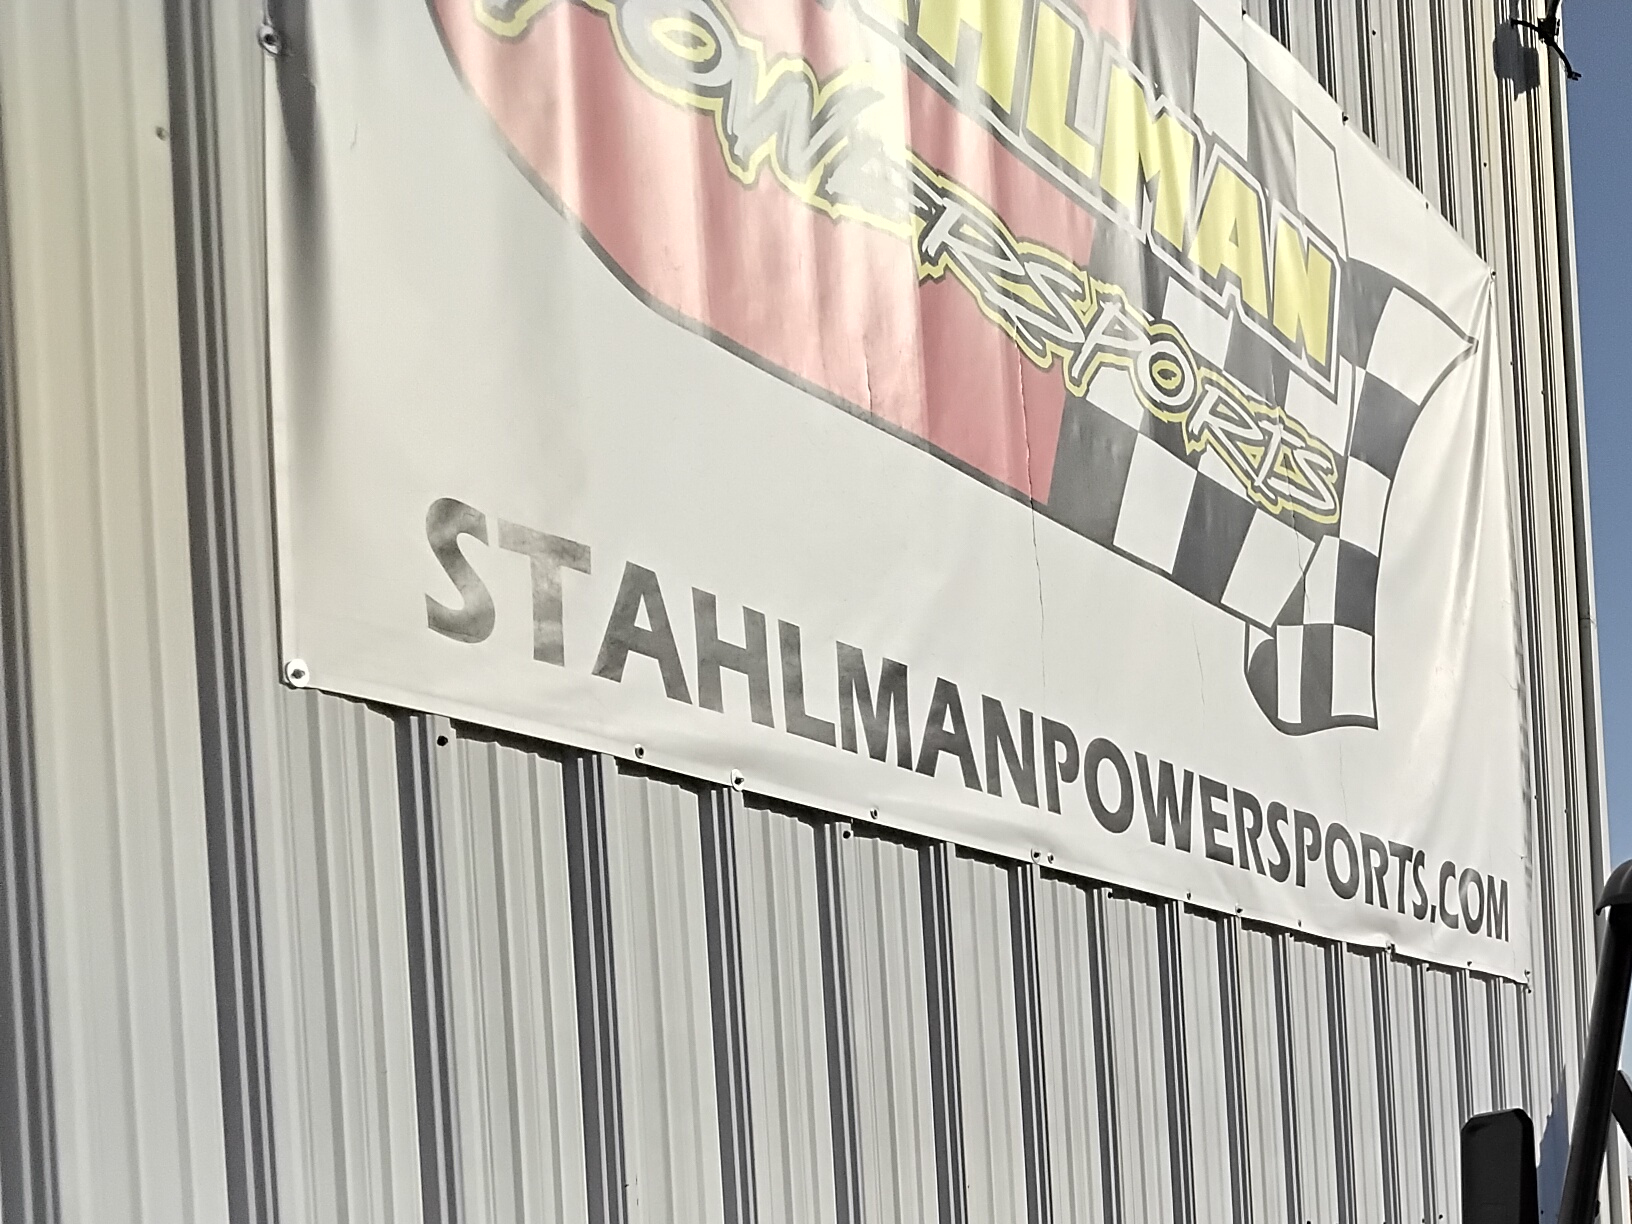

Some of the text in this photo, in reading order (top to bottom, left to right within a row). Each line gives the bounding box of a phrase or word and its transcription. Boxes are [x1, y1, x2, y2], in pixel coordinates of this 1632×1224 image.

[472, 0, 1338, 520] OWERSPORTS
[868, 0, 1334, 370] HLMAN
[424, 496, 1511, 943] STAHLMANPOWERSPORTS.COM
